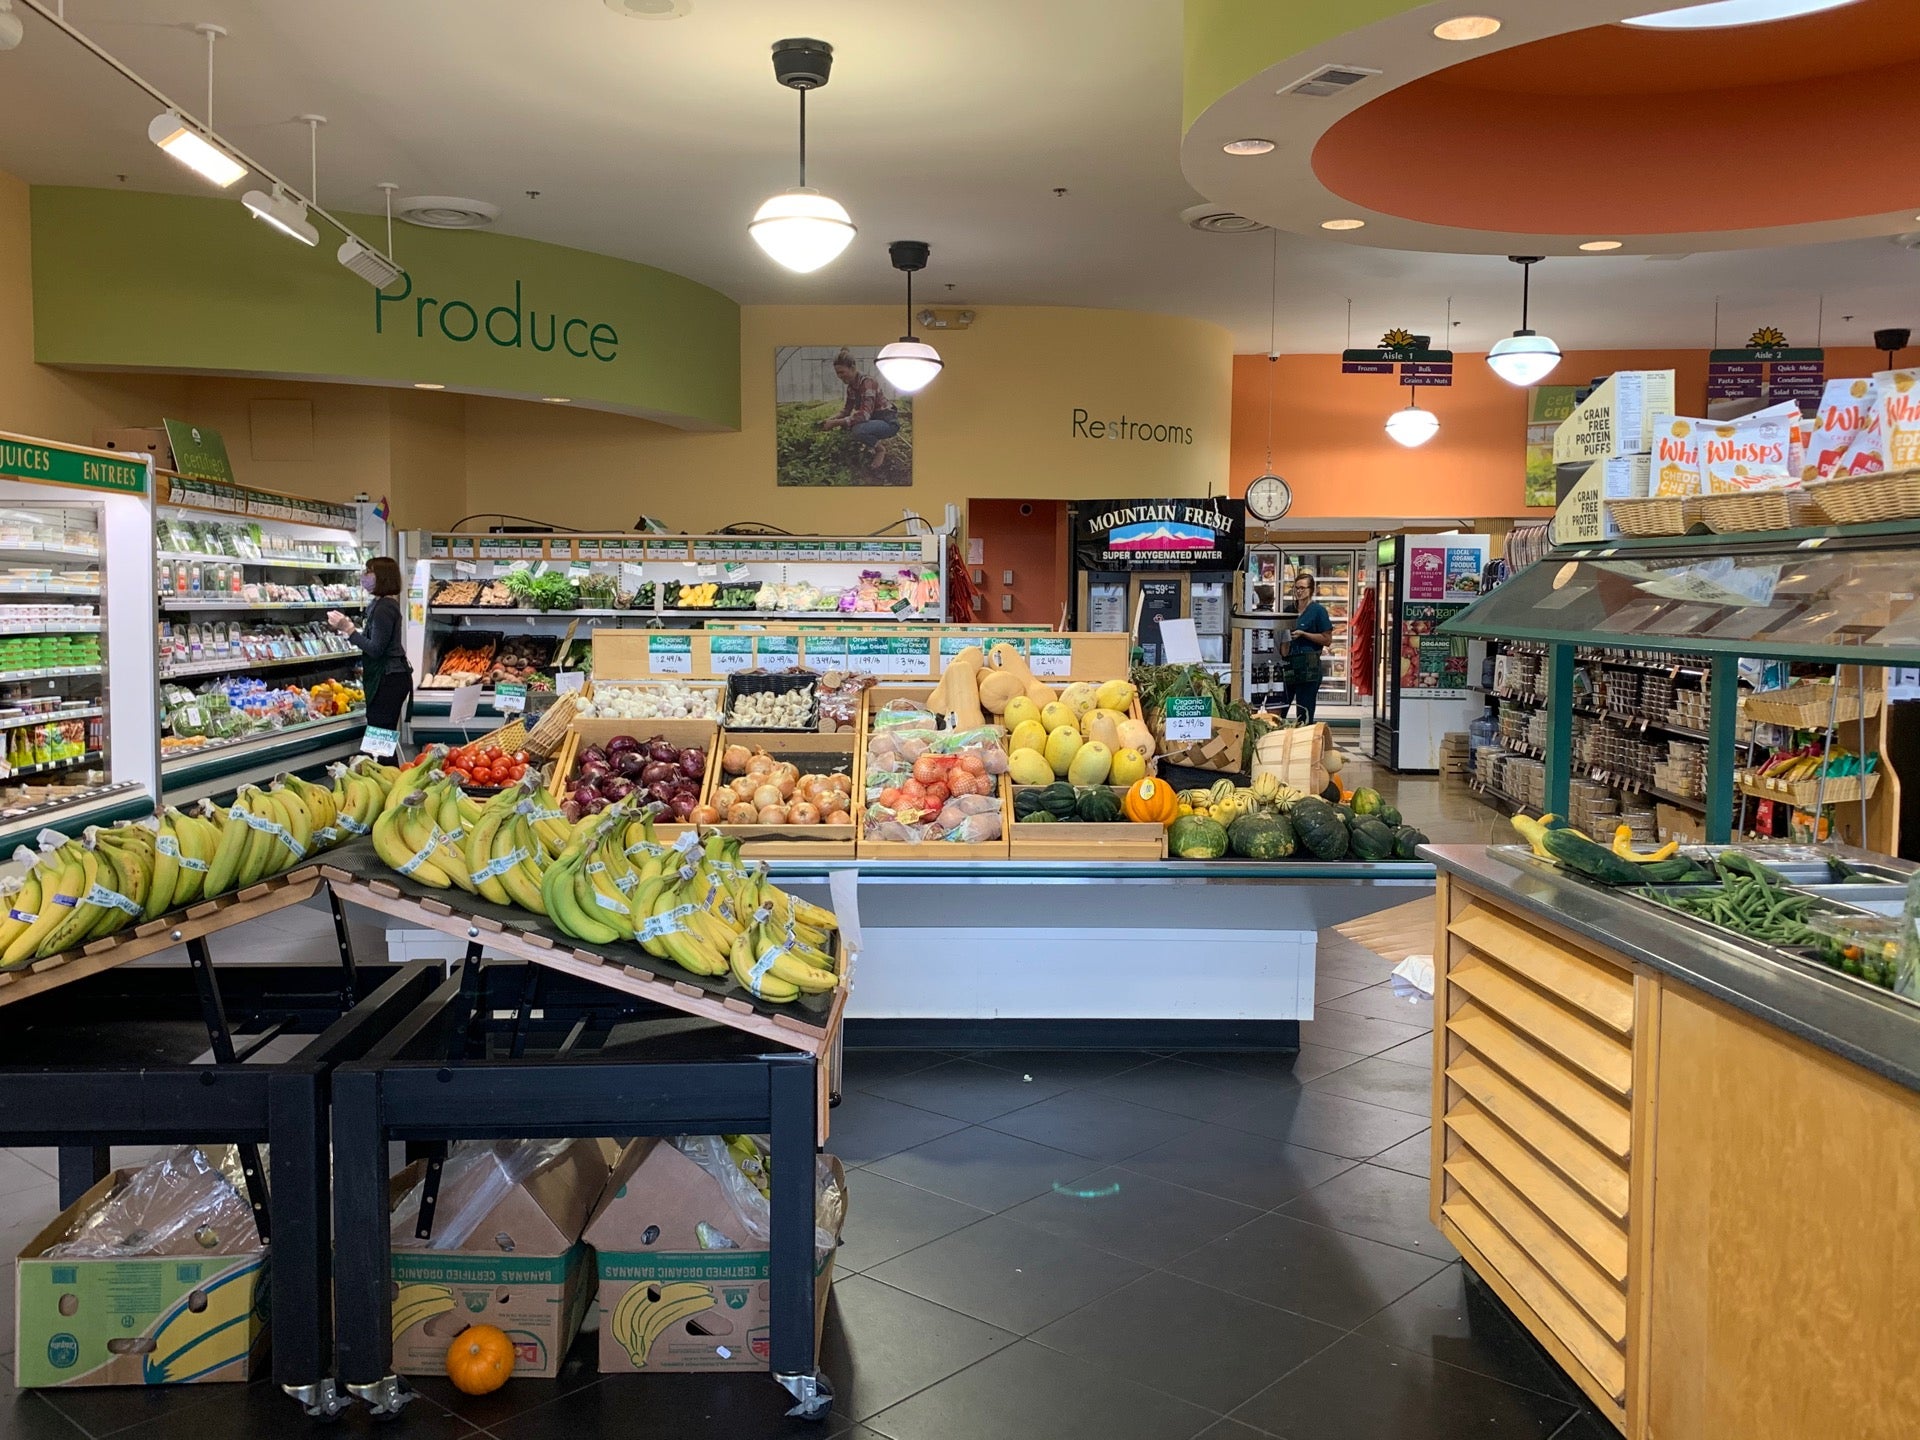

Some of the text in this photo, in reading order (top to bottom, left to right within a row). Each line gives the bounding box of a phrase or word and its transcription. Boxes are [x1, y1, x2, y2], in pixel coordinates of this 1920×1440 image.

[375, 271, 619, 362] Produce
[1382, 352, 1414, 360] Aisle 1
[1725, 389, 1744, 397] Spices
[1773, 388, 1819, 396] Salad Dressing
[1583, 407, 1610, 420] GRAIN
[1072, 408, 1193, 446] Restrooms
[1588, 419, 1610, 432] FREE
[1576, 431, 1611, 445] PROTEIN
[1584, 443, 1611, 456] PUFFS
[1706, 439, 1783, 464] Whisps
[0, 445, 136, 486] JUICES ENTREES
[1577, 490, 1599, 502] GRAIN
[1581, 501, 1598, 513] FREE
[1088, 505, 1234, 534] MOUNTAIN FRESH
[1572, 513, 1598, 526] PROTEIN
[1579, 525, 1599, 537] PUFFS
[1102, 551, 1223, 560] SUPER OXYGENATED WATER
[1405, 606, 1425, 620] buy
[656, 636, 683, 645] Organic
[718, 638, 745, 646] Organic
[769, 637, 787, 645] Local
[1174, 698, 1203, 706] Organic
[398, 1267, 552, 1282] BANANAS CERTIFIED ORGANIC
[604, 1266, 656, 1278] BANANAS
[657, 1265, 704, 1278] ORGANIC
[705, 1265, 757, 1277] CERTIFIED
